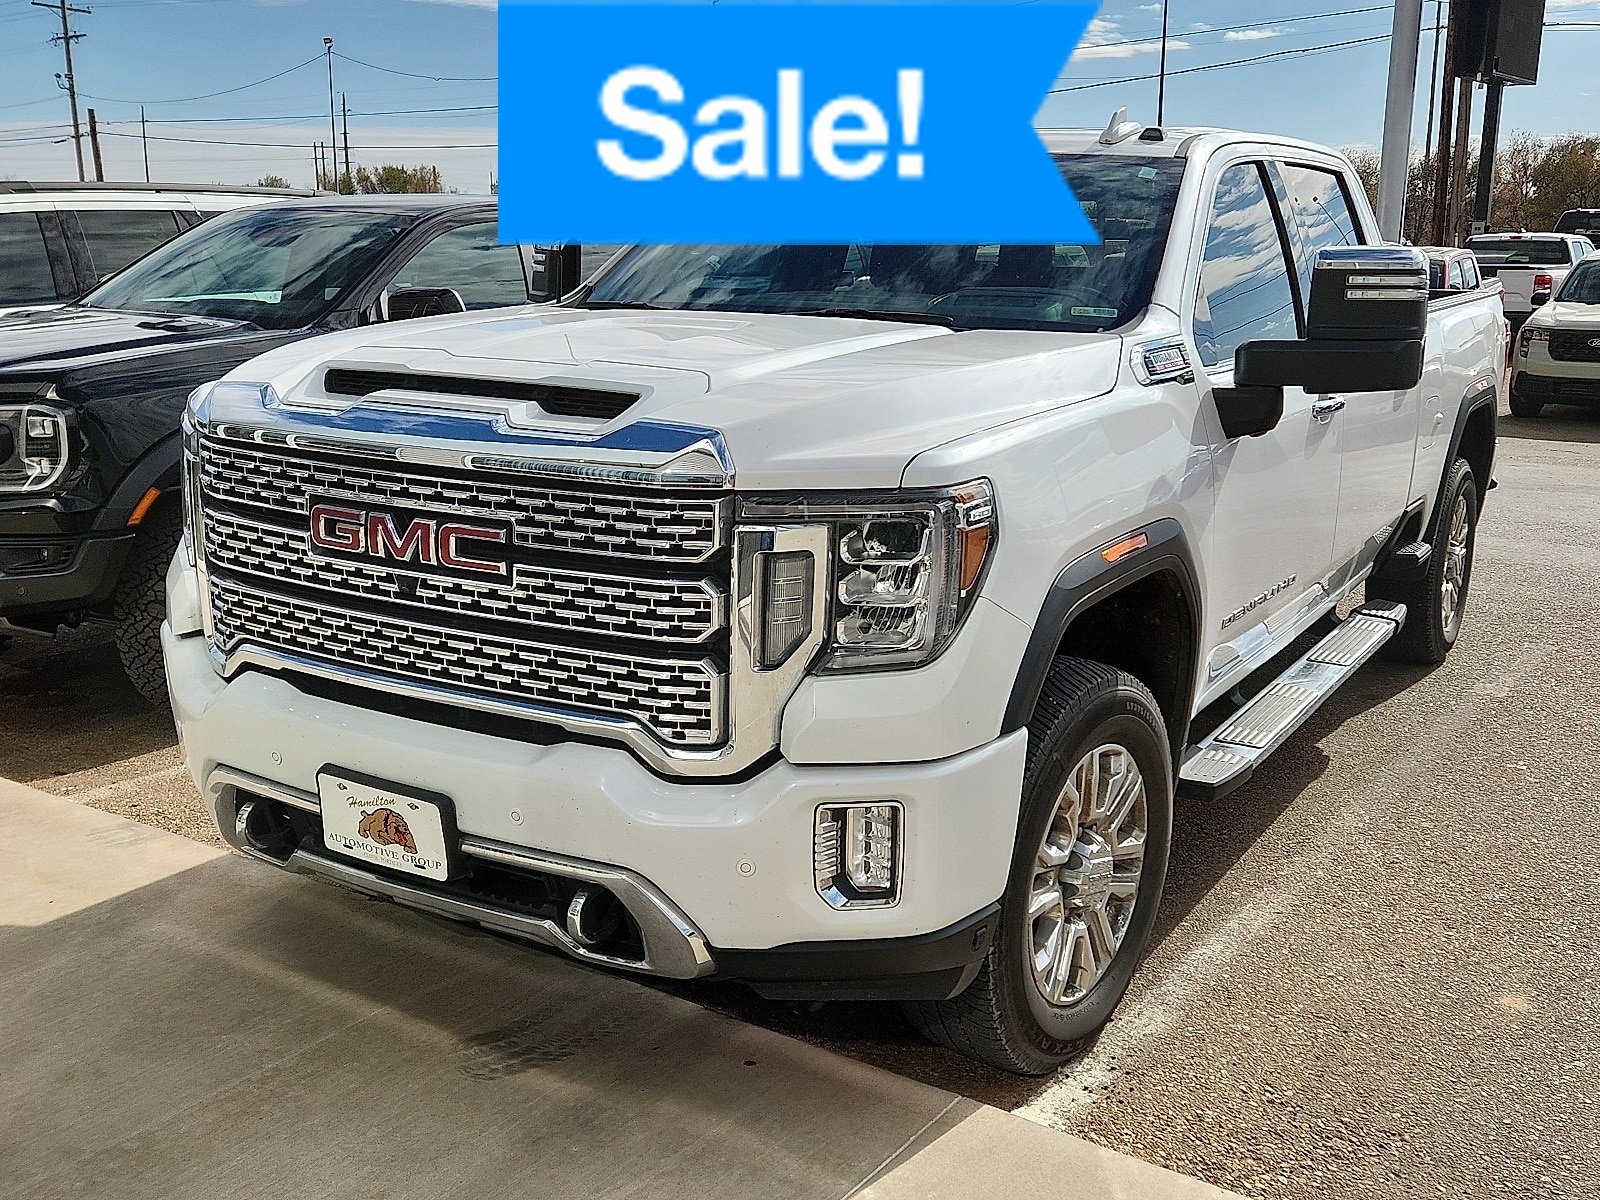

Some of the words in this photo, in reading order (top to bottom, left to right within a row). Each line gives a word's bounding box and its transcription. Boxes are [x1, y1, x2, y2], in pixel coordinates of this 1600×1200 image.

[310, 503, 507, 576] GMC
[346, 795, 396, 808] Hamilton
[328, 832, 399, 860] AUTOMOTIVE
[401, 854, 442, 870] GROUP
